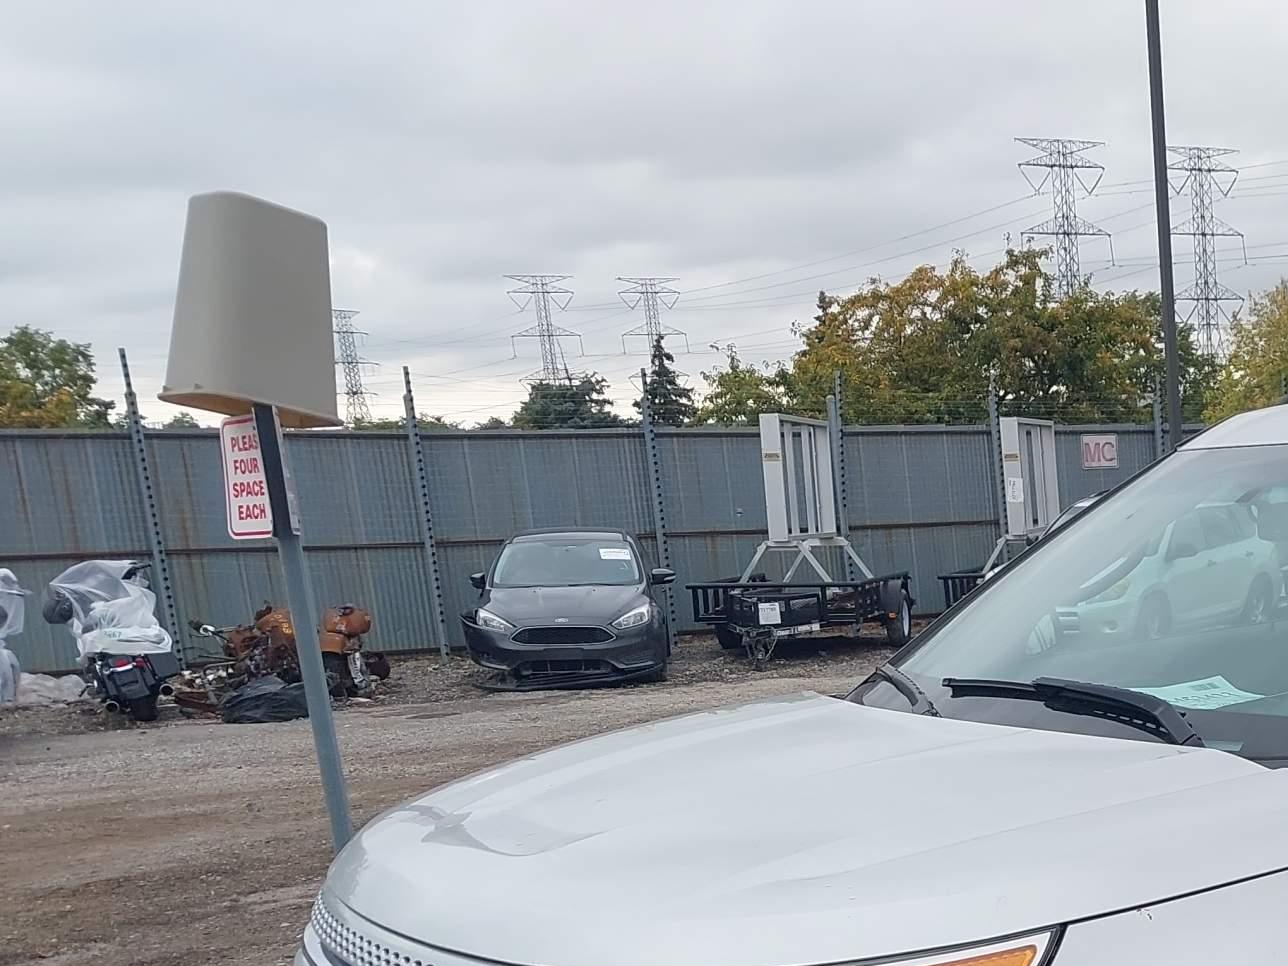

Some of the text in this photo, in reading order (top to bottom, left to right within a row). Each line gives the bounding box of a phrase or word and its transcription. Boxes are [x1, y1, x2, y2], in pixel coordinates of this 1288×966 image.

[1083, 442, 1116, 463] MC
[233, 457, 260, 475] FOUR
[232, 480, 265, 498] SPACE
[237, 503, 267, 521] EACH
